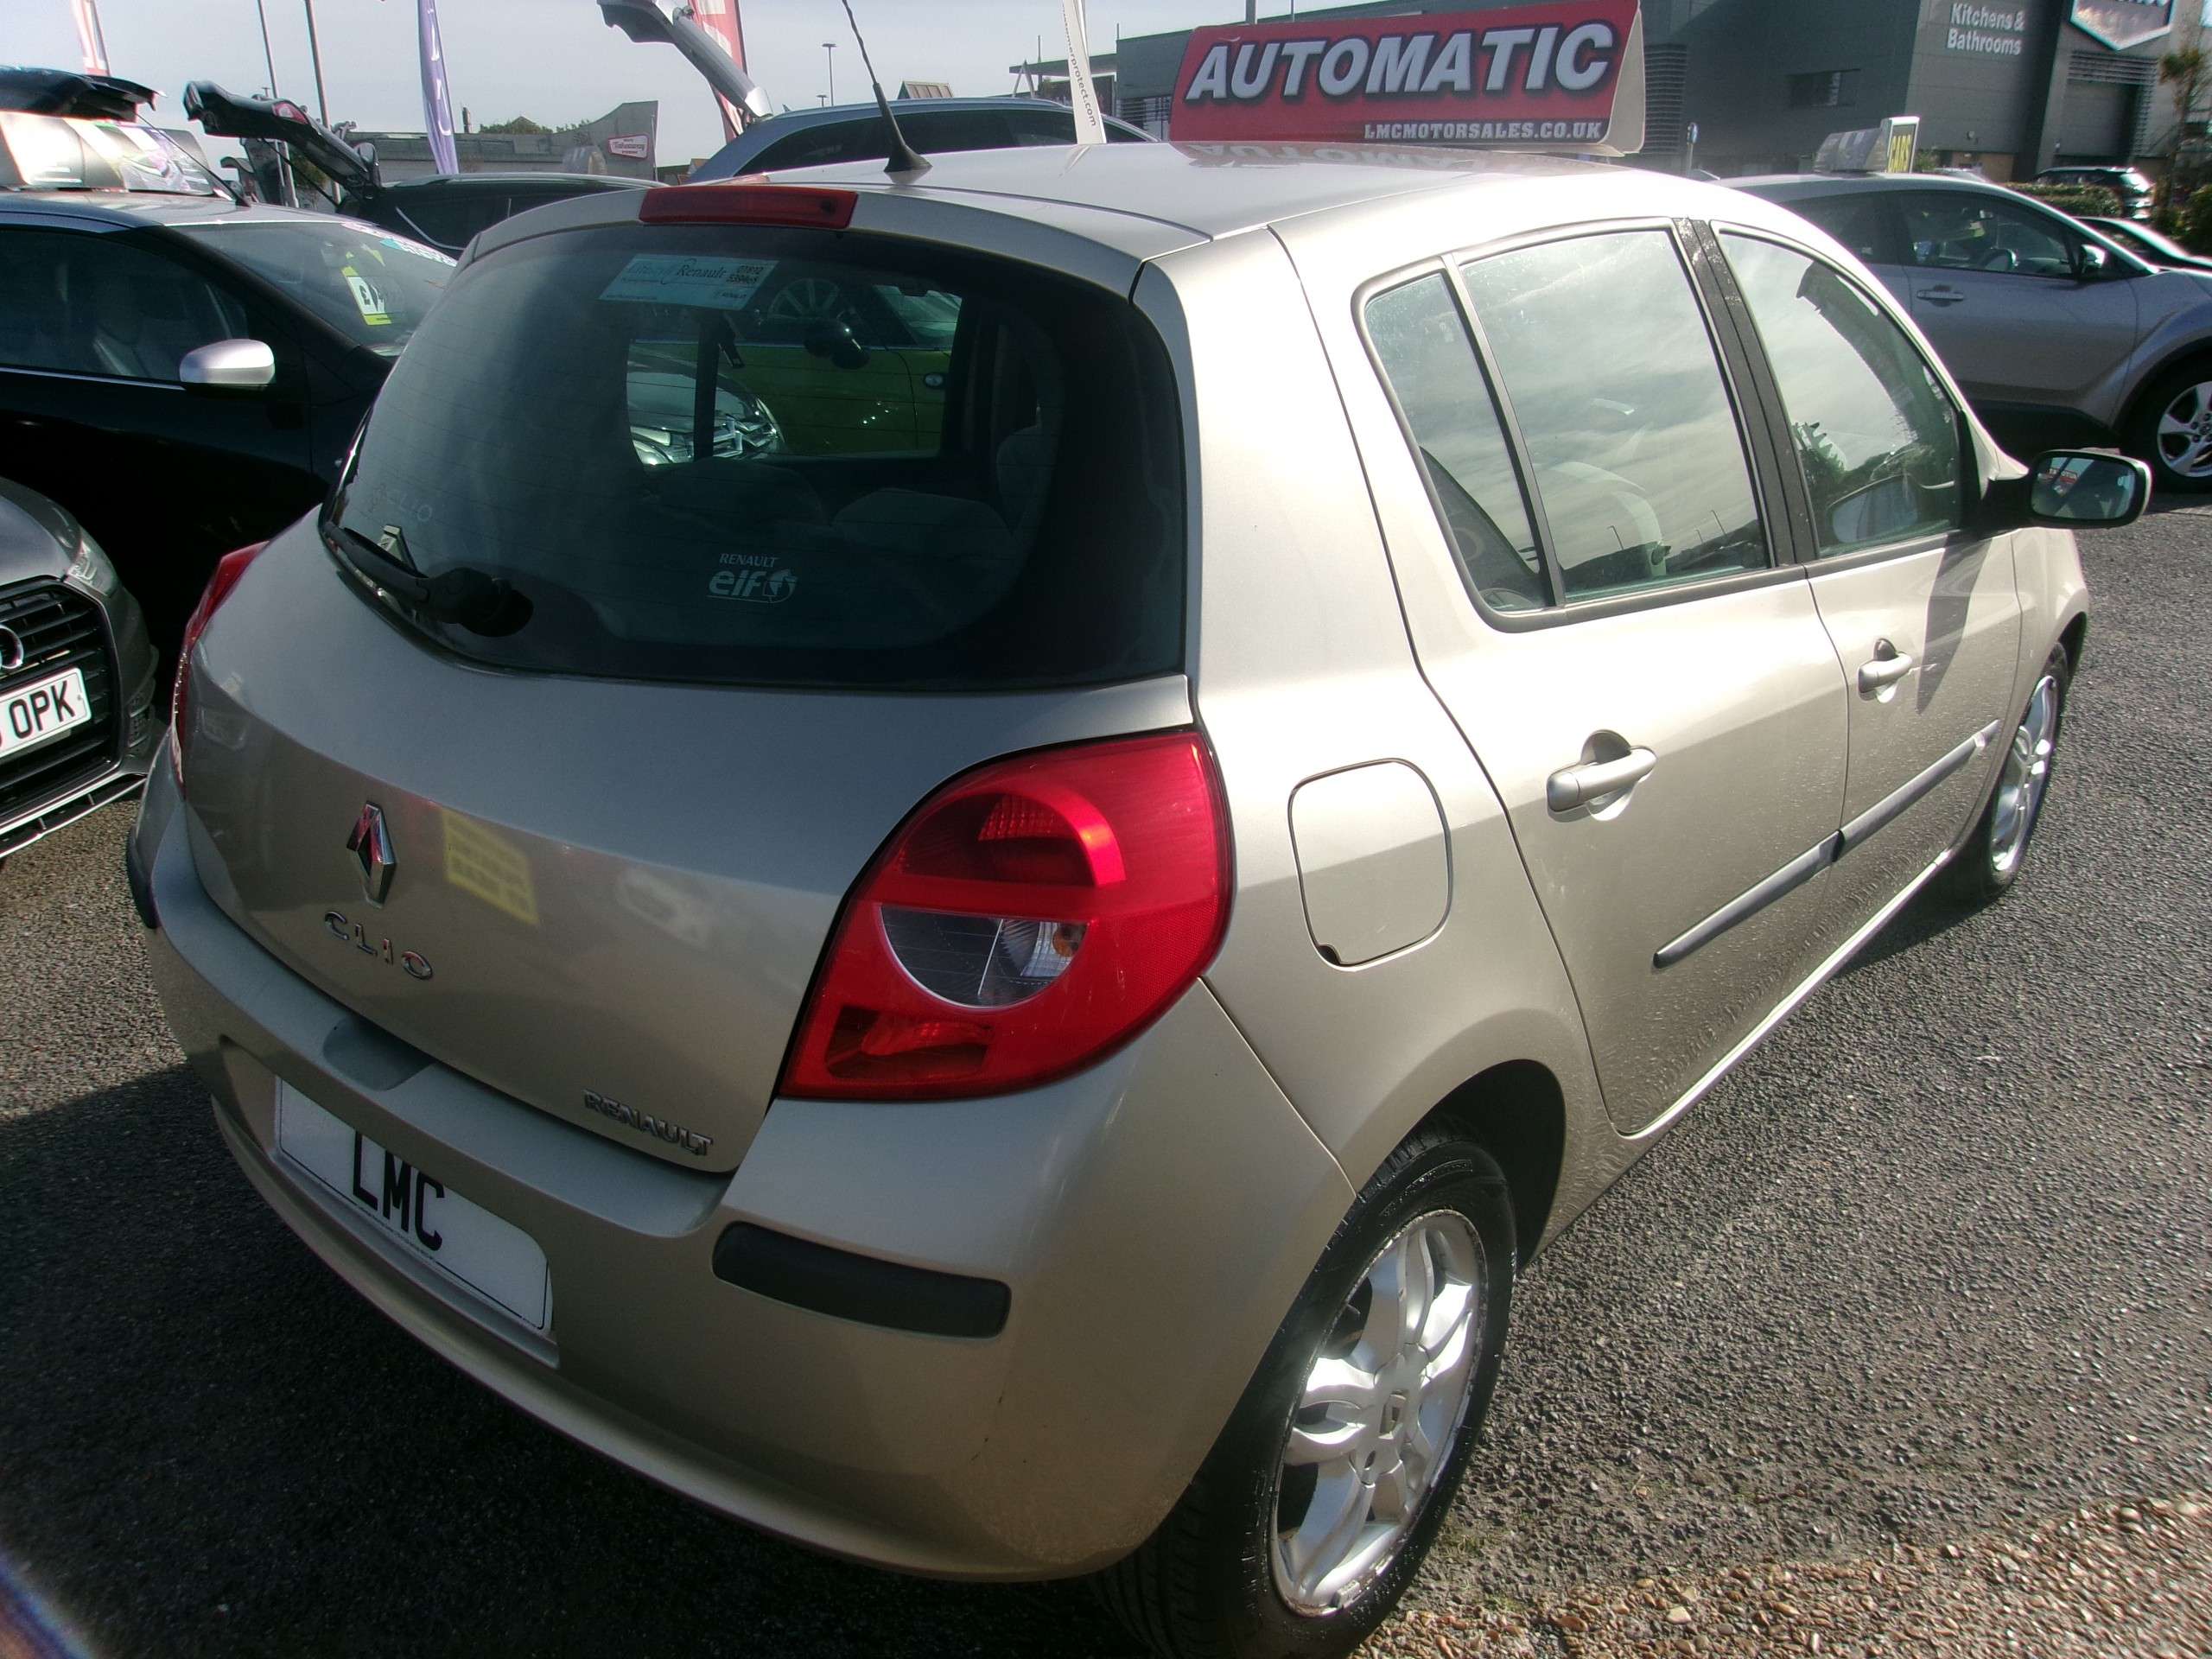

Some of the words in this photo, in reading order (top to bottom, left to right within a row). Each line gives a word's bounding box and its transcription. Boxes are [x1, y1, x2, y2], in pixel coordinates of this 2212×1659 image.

[1947, 29, 2022, 55] Bathrooms
[1950, 3, 2012, 29] Kitchens
[1185, 23, 1614, 100] AUTOMATIC
[1364, 121, 1602, 140] LMCMOTORSALES.CO.UK
[719, 552, 779, 568] RENAULT
[9, 680, 76, 740] OPK
[324, 911, 433, 981] CLIO
[582, 1089, 715, 1157] RENAULT
[353, 1130, 446, 1252] LMC
